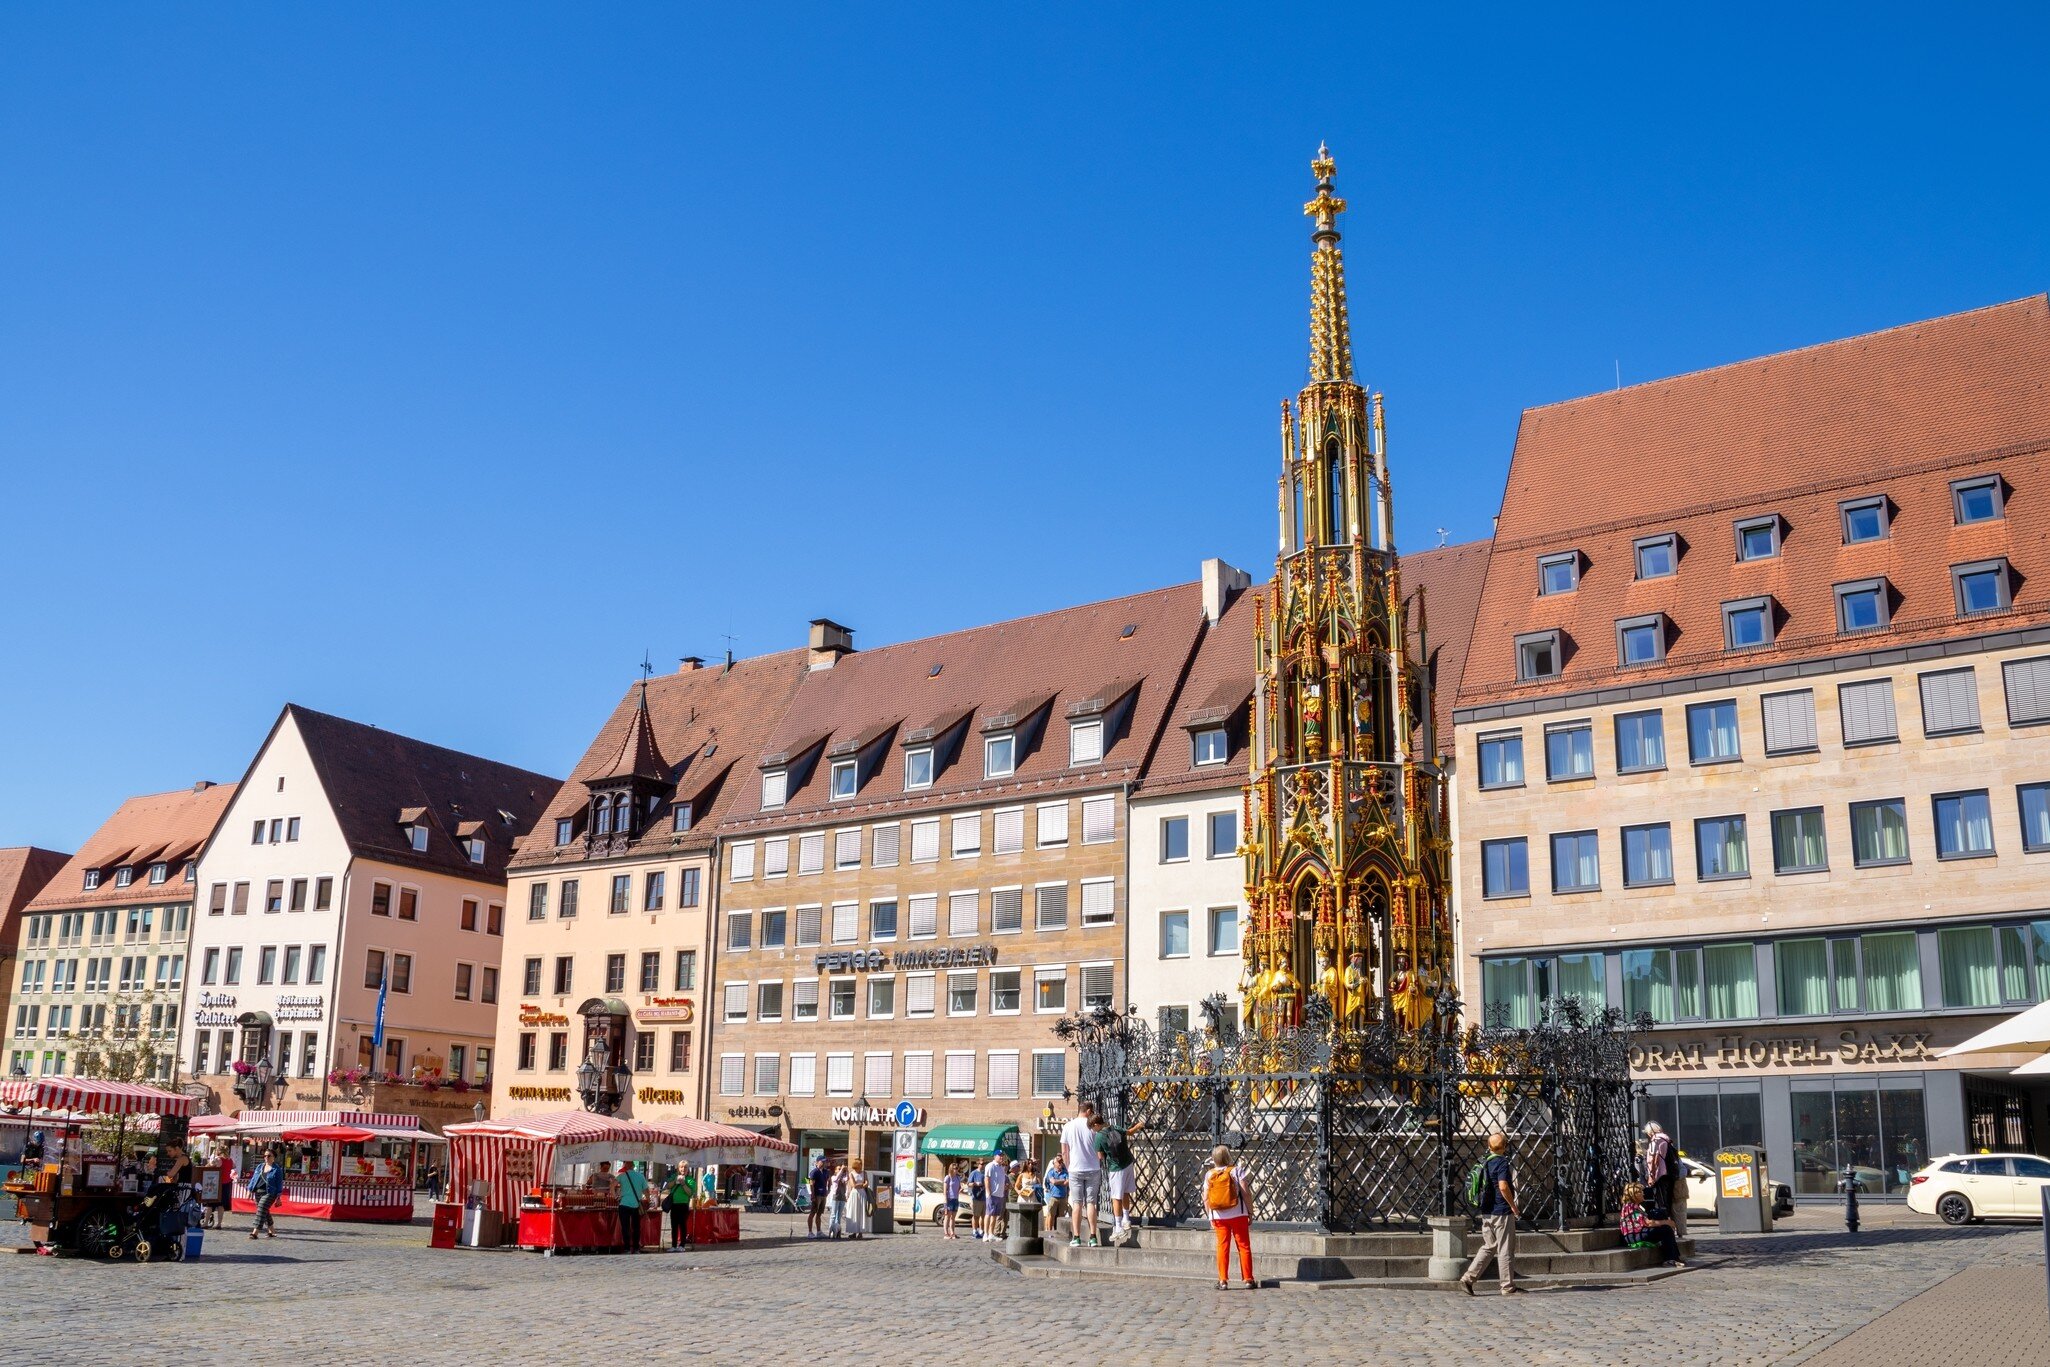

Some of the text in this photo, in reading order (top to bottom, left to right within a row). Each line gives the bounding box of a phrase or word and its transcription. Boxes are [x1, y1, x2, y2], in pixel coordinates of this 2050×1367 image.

[892, 944, 996, 967] IMMOBILIEN
[1628, 1030, 1932, 1068] ORAT HOTEL SAXX
[638, 1087, 682, 1101] BÜCHER
